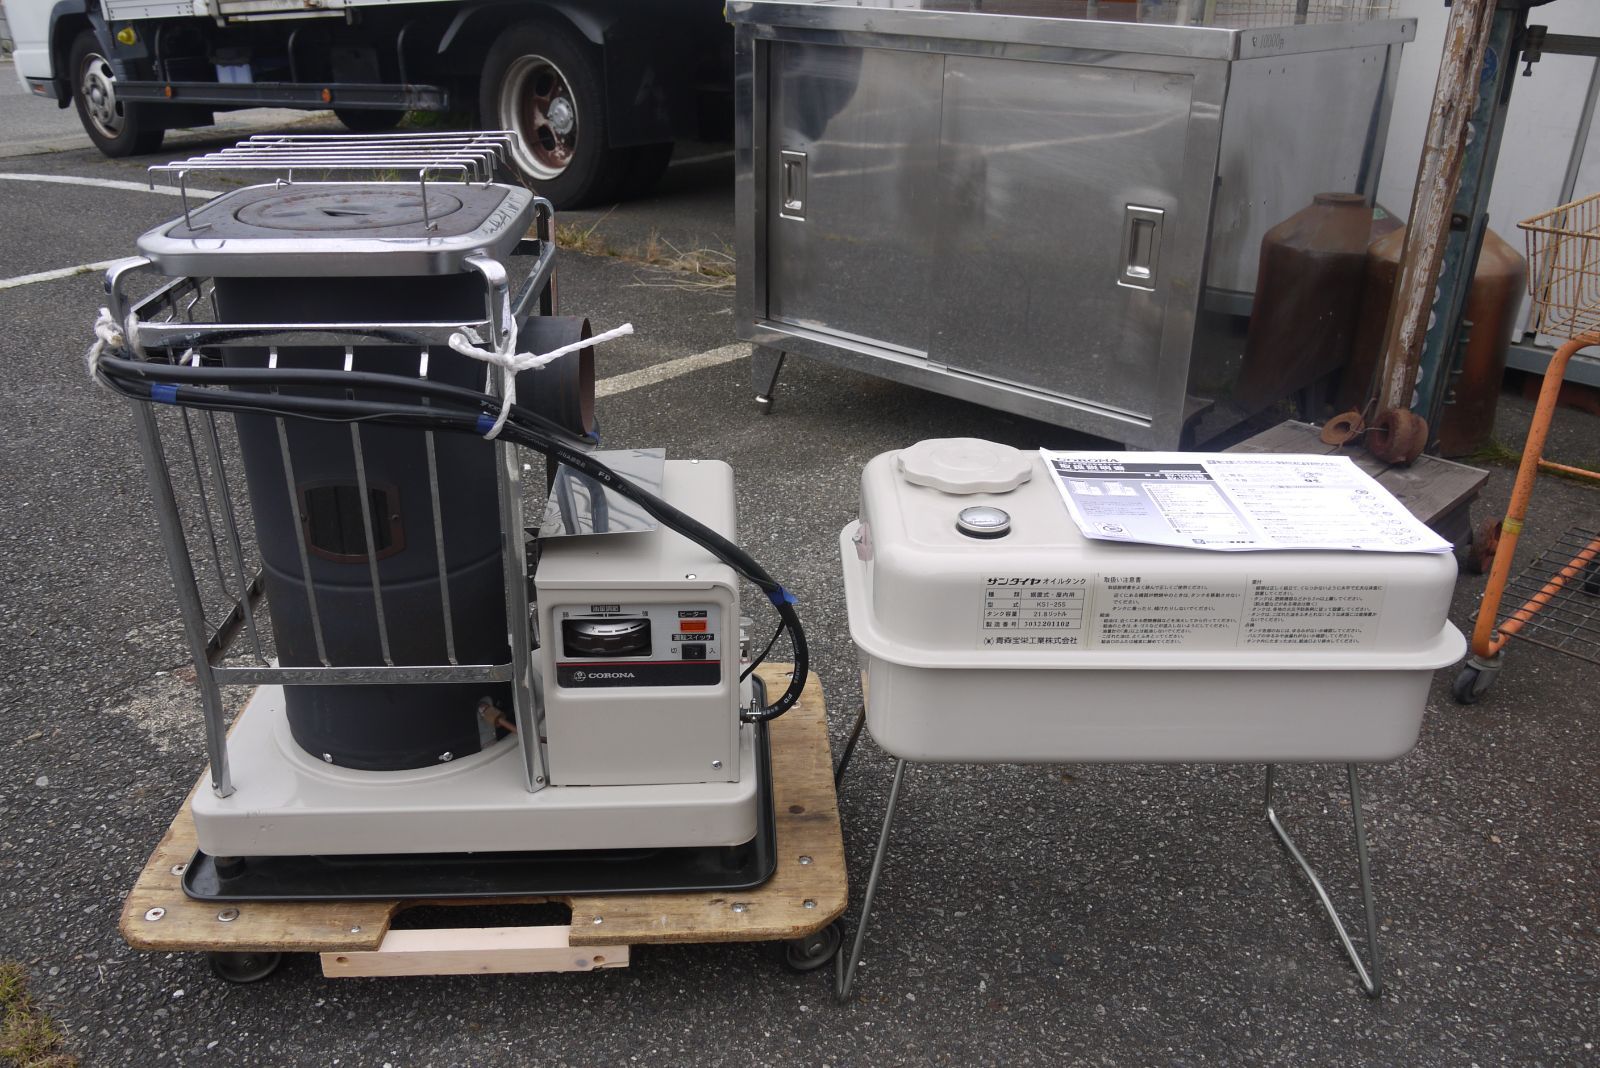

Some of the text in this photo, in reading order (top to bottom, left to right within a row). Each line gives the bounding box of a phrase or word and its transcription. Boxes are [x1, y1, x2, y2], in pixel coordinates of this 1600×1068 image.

[986, 577, 1087, 586] サンダイヤ オイルタンク
[671, 647, 678, 655] 切
